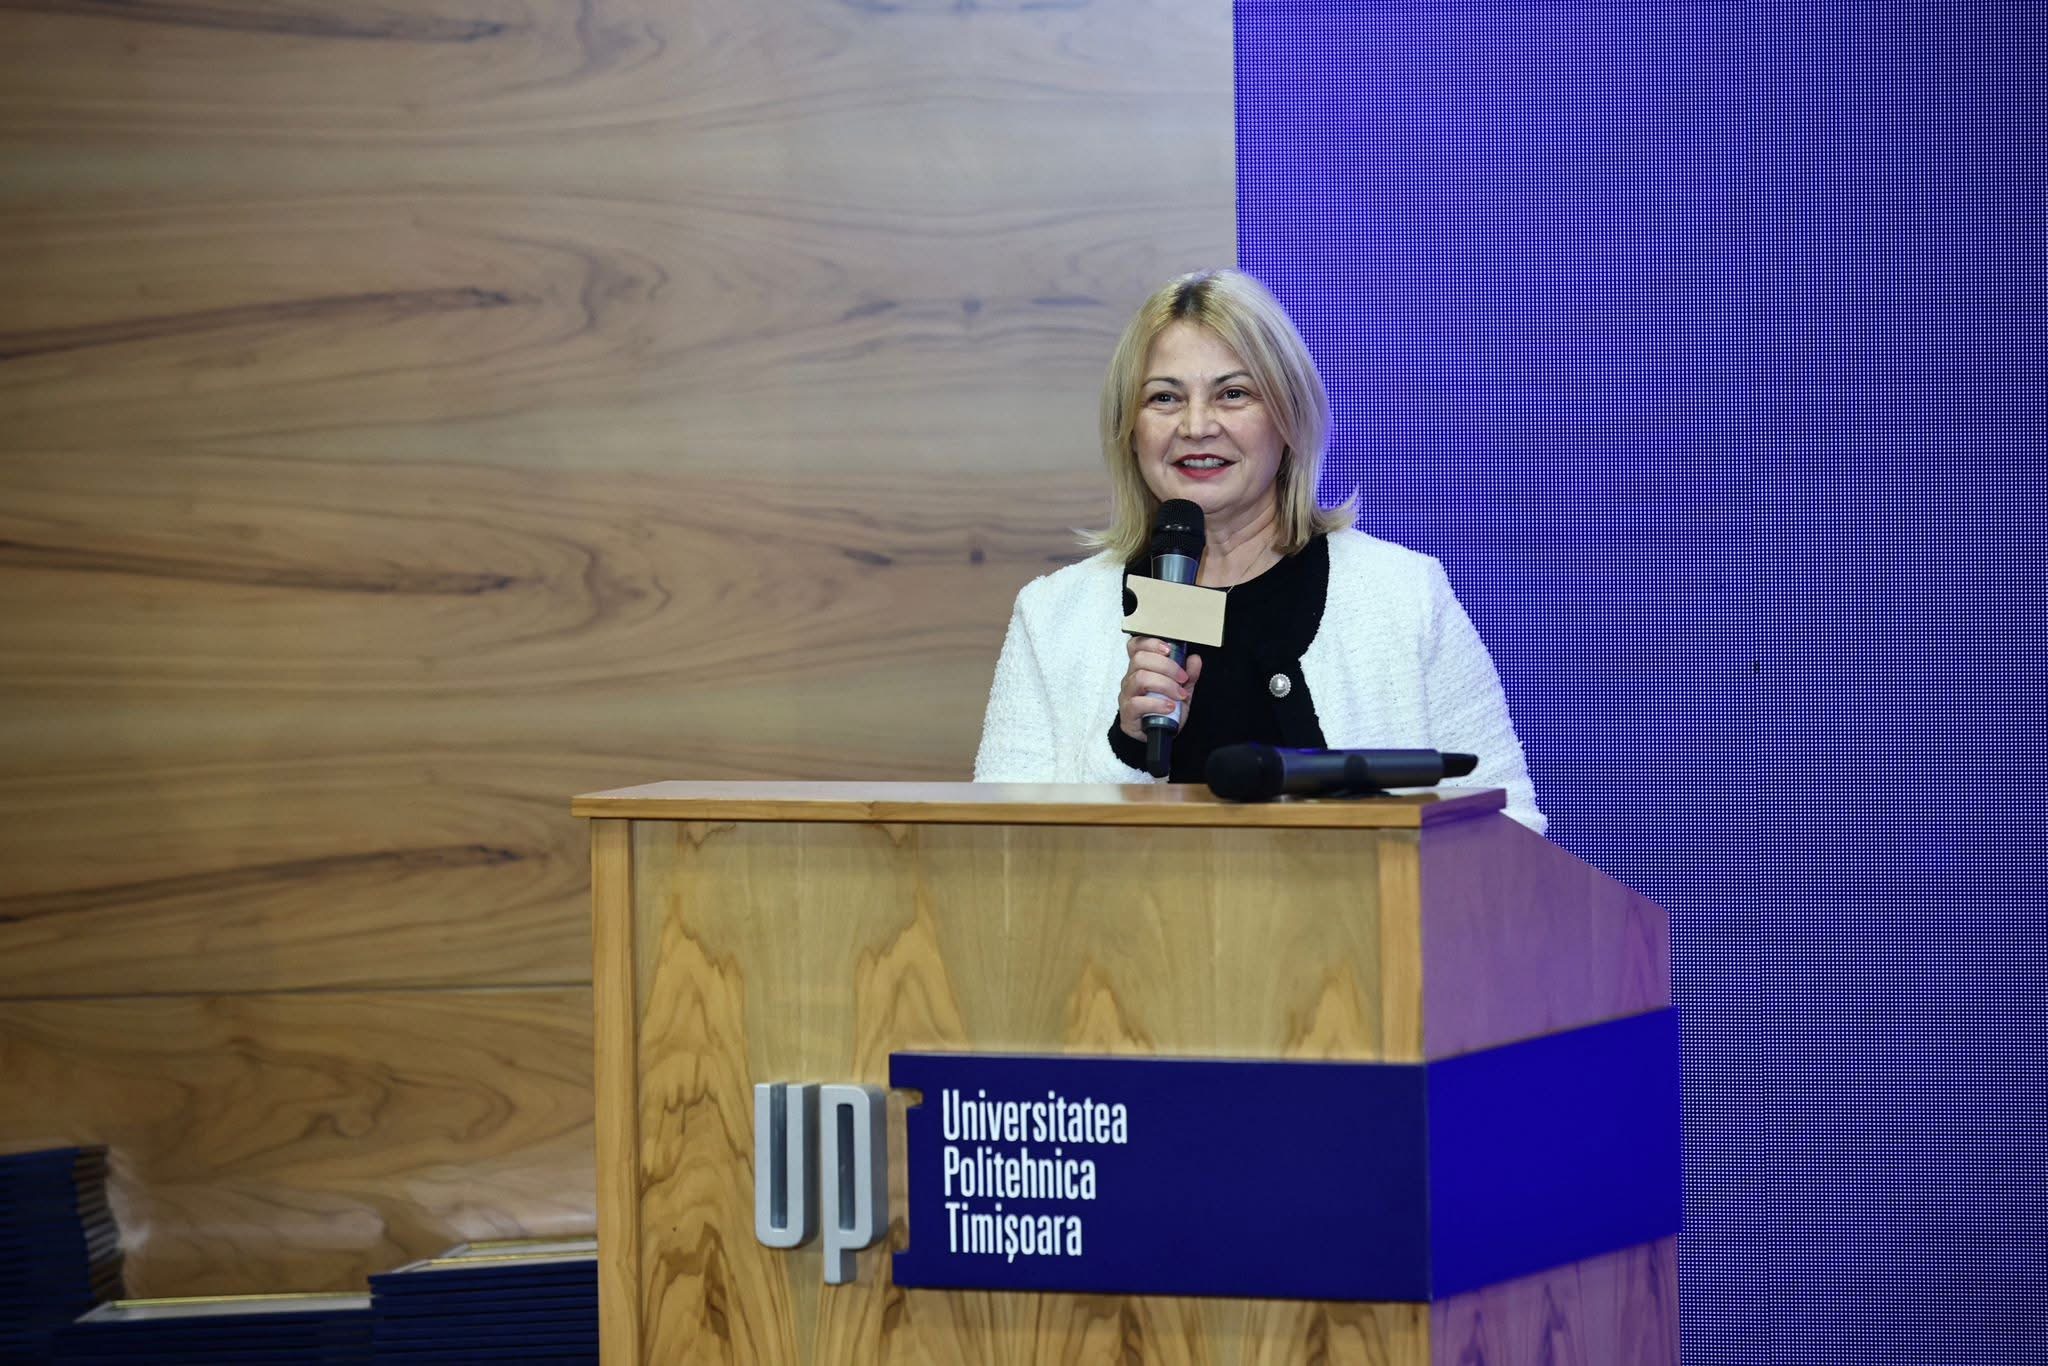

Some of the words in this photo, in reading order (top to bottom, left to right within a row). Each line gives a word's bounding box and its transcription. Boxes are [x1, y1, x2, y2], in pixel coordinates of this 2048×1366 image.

[941, 1088, 1128, 1144] Universitatea
[943, 1145, 1096, 1200] Politehnica
[944, 1201, 1082, 1264] Timișoara
